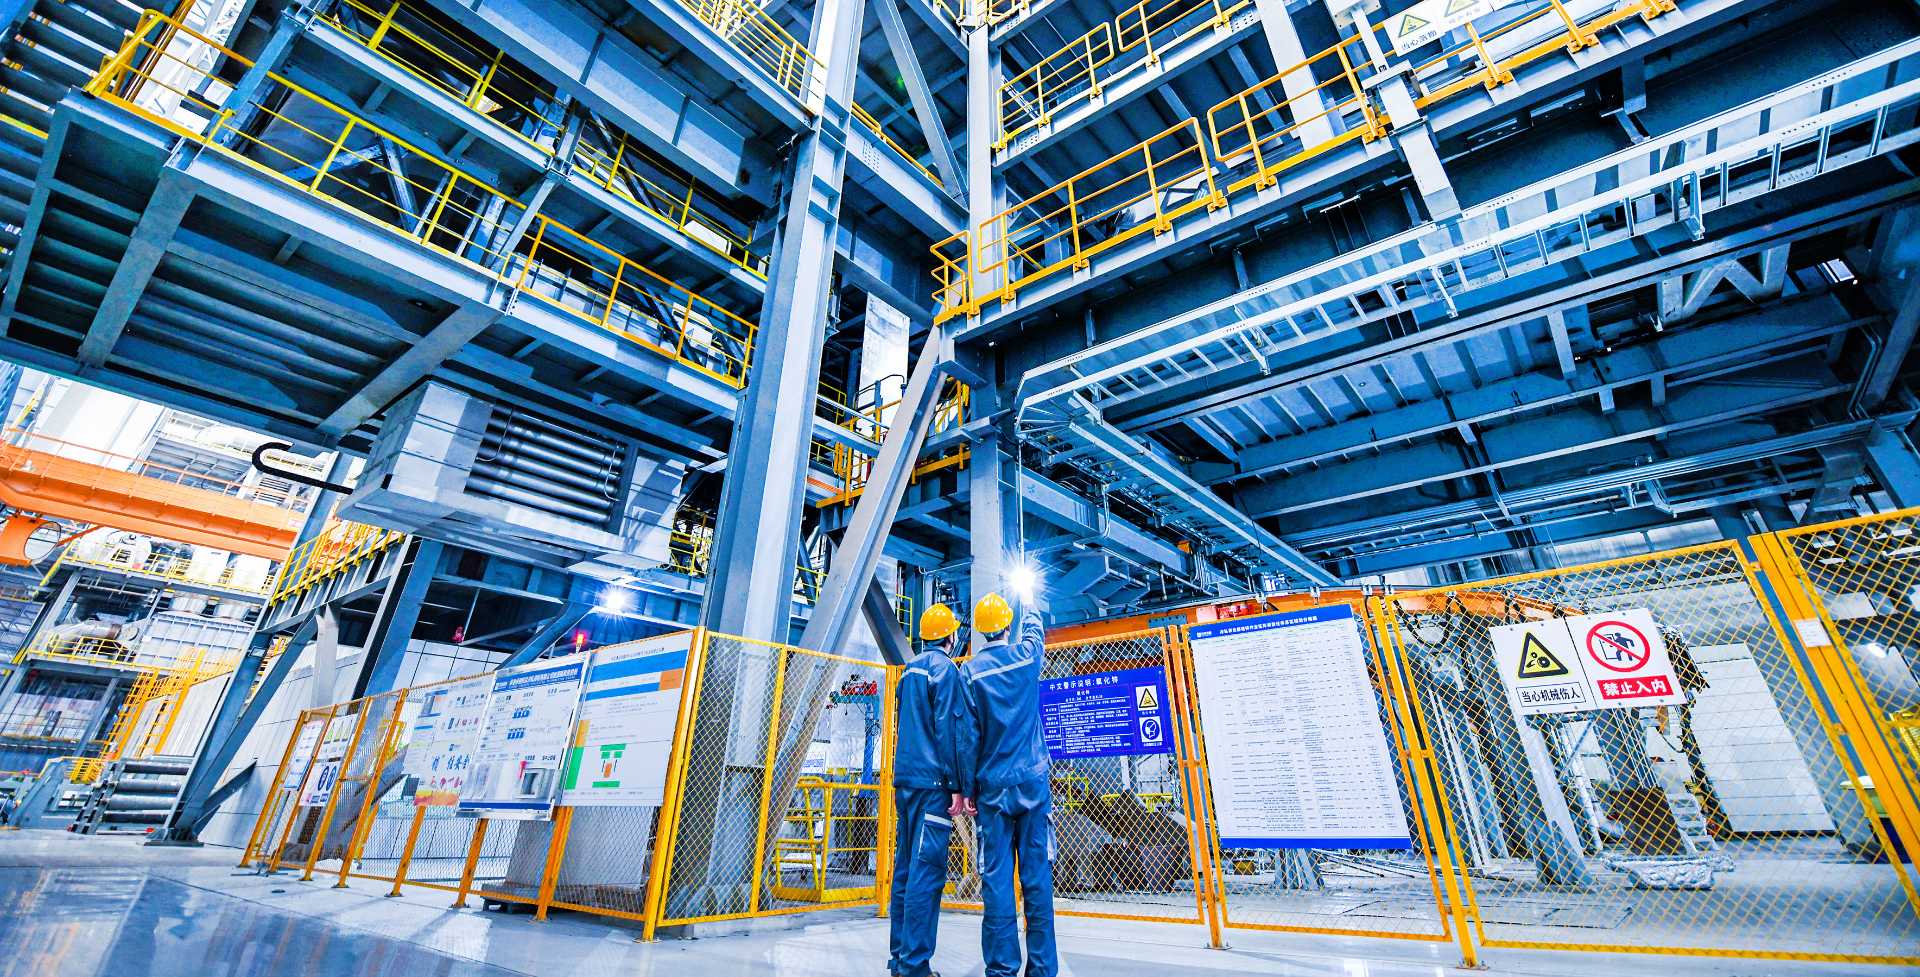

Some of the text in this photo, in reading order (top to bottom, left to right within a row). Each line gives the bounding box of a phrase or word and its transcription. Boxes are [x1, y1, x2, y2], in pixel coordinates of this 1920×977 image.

[1521, 685, 1581, 703] 当心机械伤人
[1603, 679, 1667, 697] 禁止入内
